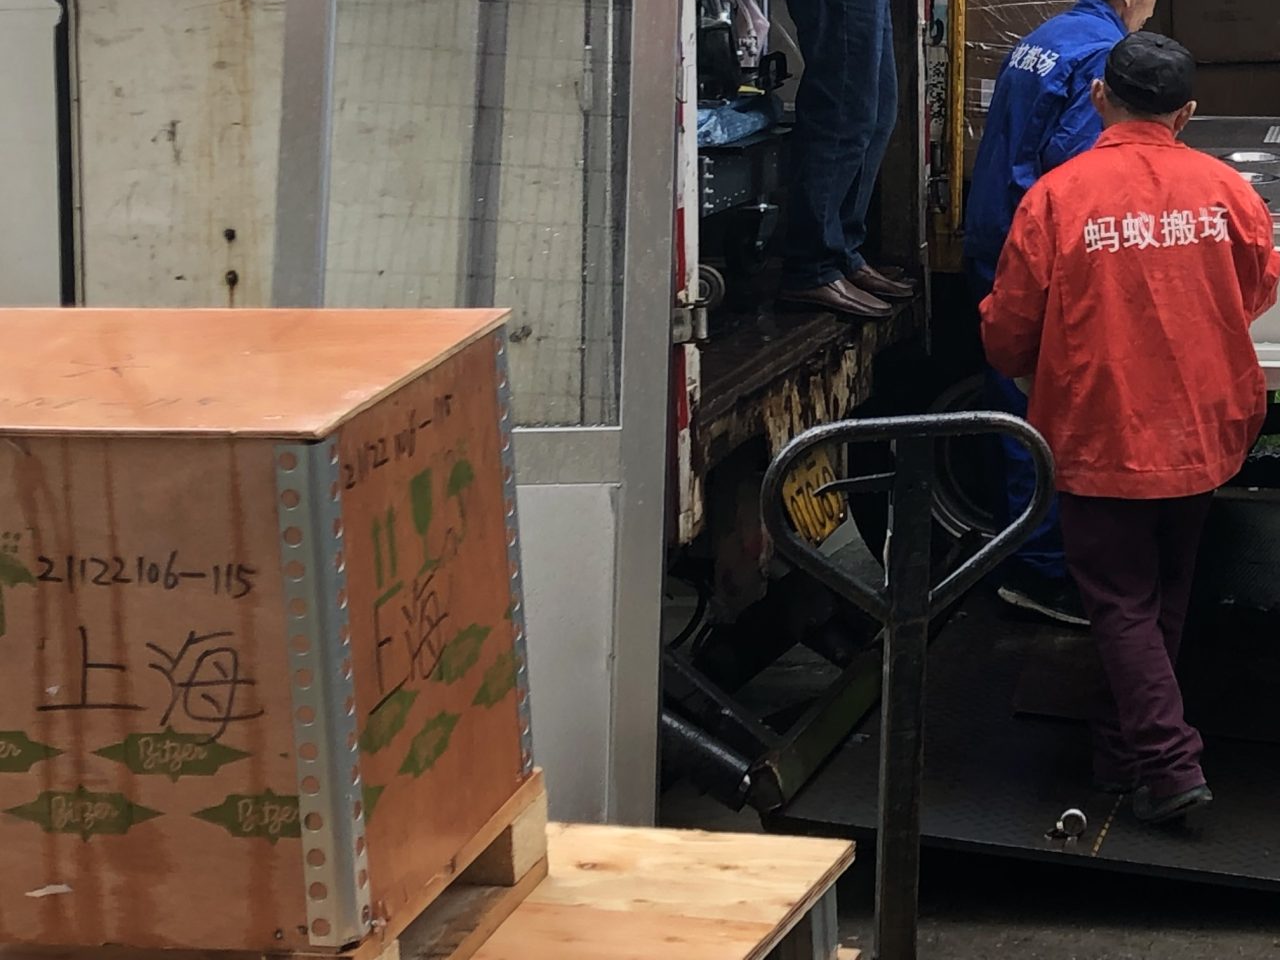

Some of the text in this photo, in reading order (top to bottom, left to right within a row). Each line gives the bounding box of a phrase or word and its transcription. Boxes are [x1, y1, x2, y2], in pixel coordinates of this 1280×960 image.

[1084, 207, 1231, 253] 蚂蚁搬场
[37, 550, 257, 599] 21122106-115
[37, 625, 265, 745] 上海
